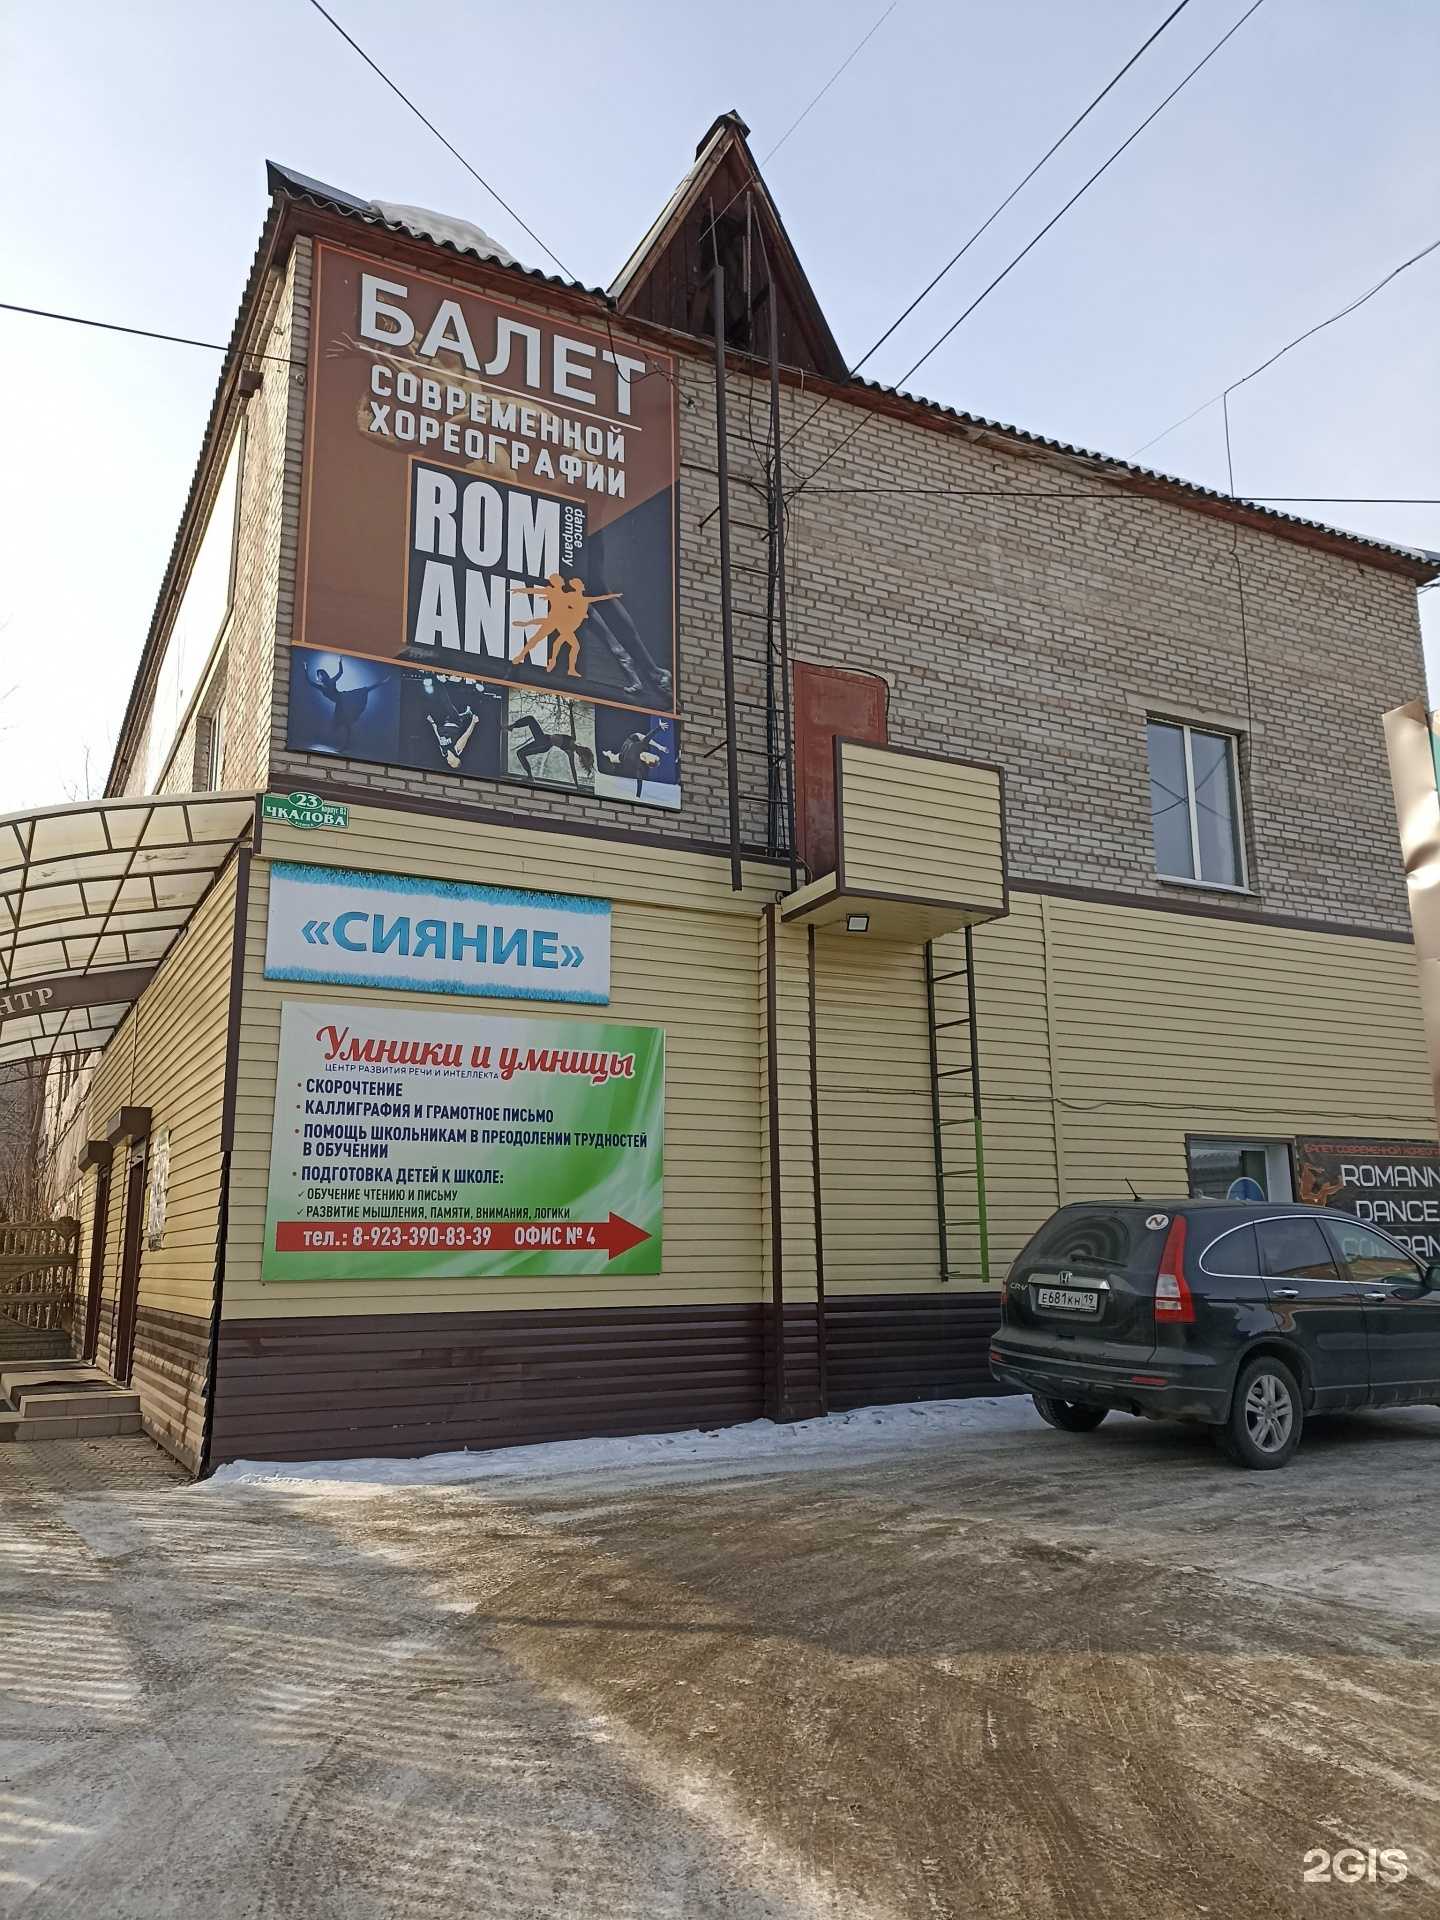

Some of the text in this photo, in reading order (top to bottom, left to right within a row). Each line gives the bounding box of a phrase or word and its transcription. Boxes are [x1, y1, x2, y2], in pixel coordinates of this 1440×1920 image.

[360, 273, 646, 416] БАЛЕТ
[370, 365, 625, 463] СОВРЕМЕННОЙ
[369, 401, 625, 498] ХОРЕОГРАФИИ
[415, 467, 560, 580] ROM
[574, 508, 585, 548] dance
[562, 506, 573, 567] company
[414, 559, 549, 667] ANN
[296, 794, 318, 807] 23
[266, 805, 345, 825] ЧКАЛОВА
[301, 911, 585, 969] «СИЯНИЕ»
[316, 1025, 634, 1084] Умники и умницы
[325, 1063, 499, 1079] ЦЕНТР РАЗВИТИЯ РЕЧИ И ИНТЕЛЛЕКТА
[306, 1079, 403, 1096] СКОРОЧТЕНИЕ
[305, 1100, 554, 1123] КАЛЛИГРАФИЯ И ГРАМОТНОЕ ПИСЬМО
[304, 1124, 647, 1148] ПОМОЩЬ ШКОЛЬНИКАМ В ПРЕОДОЛЕНИИ ТРУДНОСТЕЙ
[303, 1142, 388, 1158] В ОБУЧЕНИИ
[301, 1166, 504, 1185] ПОДГОТОВКА ДЕТЕЙ К ШКОЛЕ:
[307, 1188, 458, 1201] ОБУЧЕНИЕ ЧТЕНИЮ И ПИСЬМУ
[306, 1206, 570, 1220] РАЗВИТИЕ МЫШЛЕНИЯ, ПАМЯТИ, ВНИМАНИЯ, ЛОГИКИ
[1355, 1200, 1440, 1222] DANCE
[303, 1226, 596, 1246] тел.: 8-923-390-83-39 ОФИС № 4
[1083, 1294, 1094, 1304] 19
